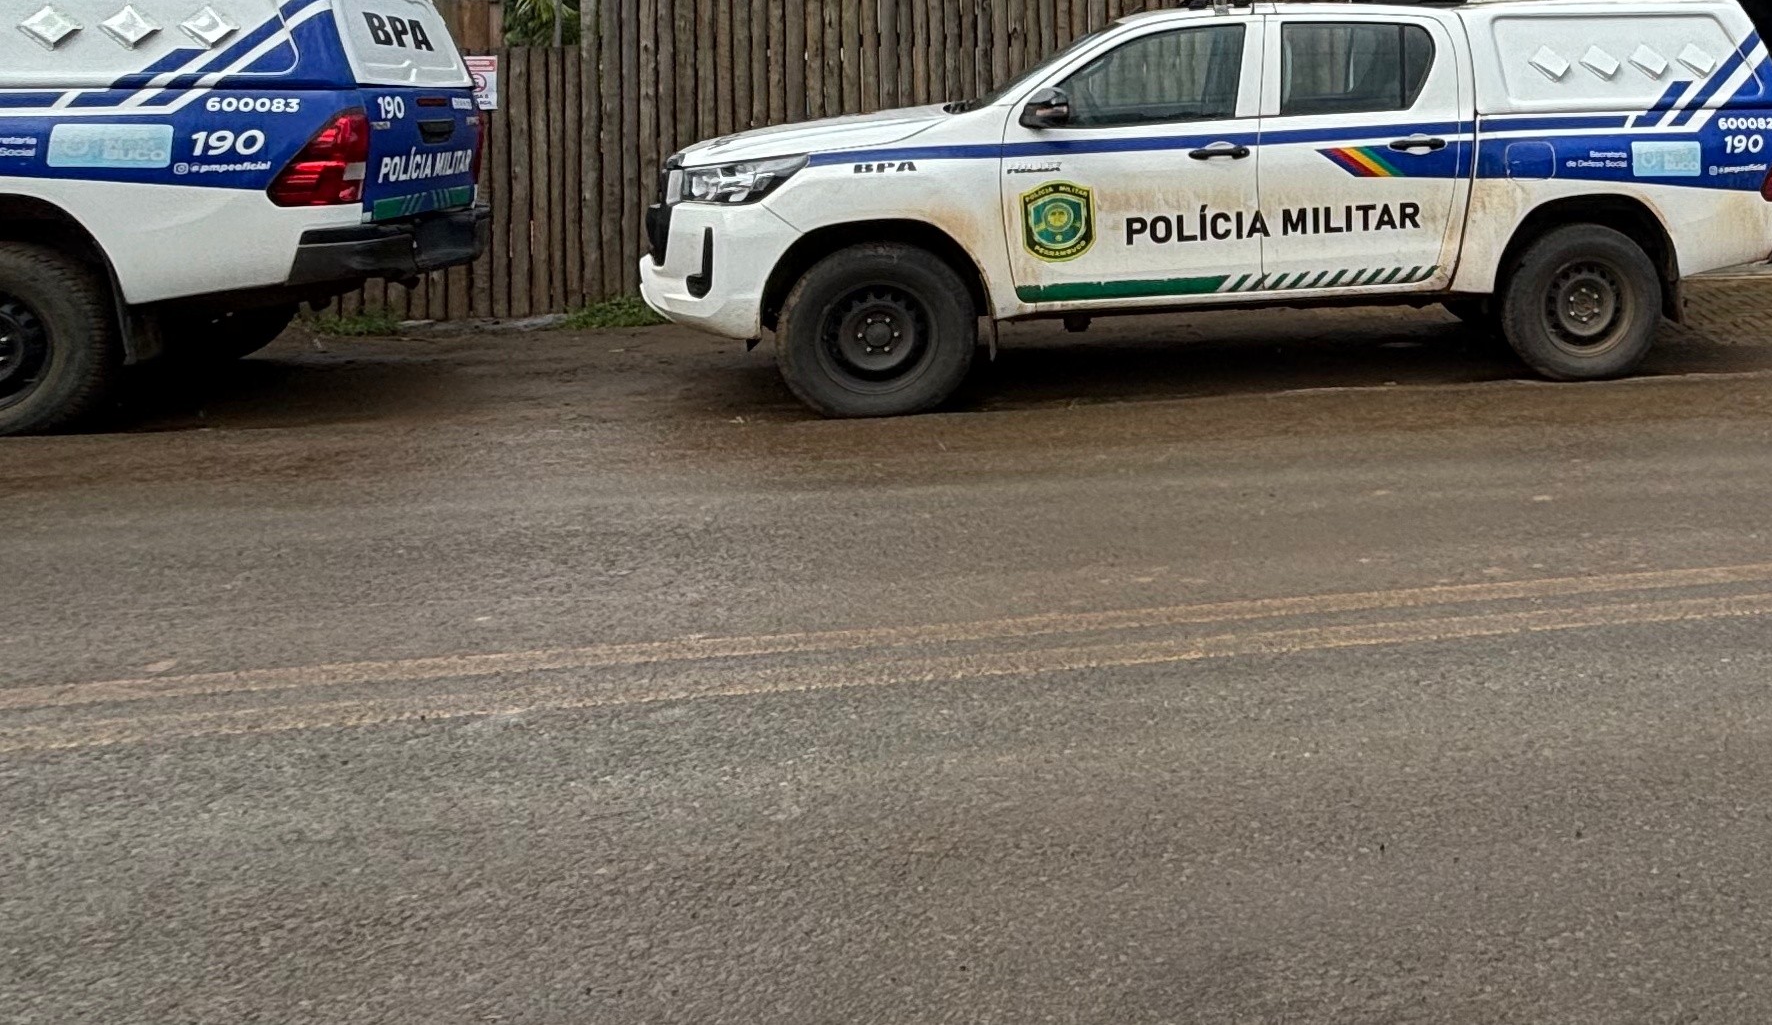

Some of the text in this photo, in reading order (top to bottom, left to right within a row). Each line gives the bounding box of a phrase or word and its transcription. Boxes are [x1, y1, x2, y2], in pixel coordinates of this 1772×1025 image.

[362, 11, 435, 52] BPA
[206, 97, 300, 113] 600083
[377, 96, 405, 119] 190
[191, 129, 265, 156] 190
[1724, 134, 1764, 154] 190
[378, 146, 473, 184] POLÍCIA MILITAR
[853, 161, 918, 174] BPA
[1126, 202, 1421, 245] POLÍCIA MILITAR
